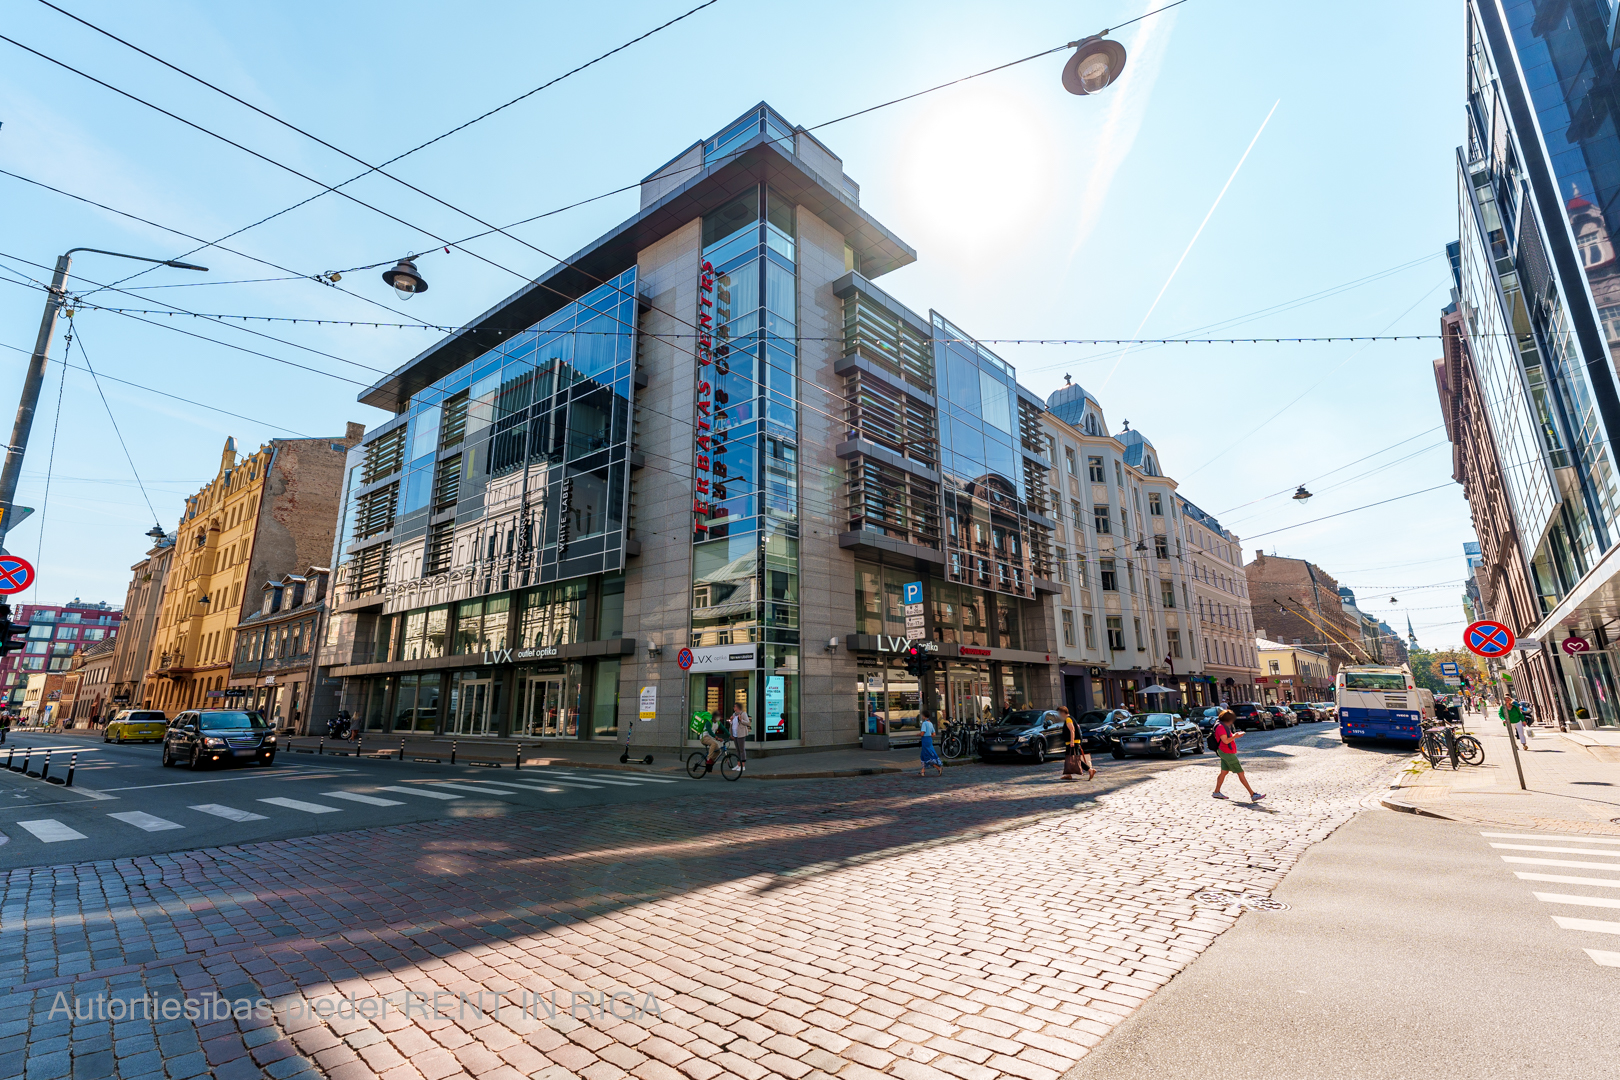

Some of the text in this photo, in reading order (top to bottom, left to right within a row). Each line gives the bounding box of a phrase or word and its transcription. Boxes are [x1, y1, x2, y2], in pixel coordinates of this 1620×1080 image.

[699, 259, 714, 366] CENTRS
[908, 585, 918, 602] P
[877, 634, 912, 654] LVX
[484, 646, 557, 665] LVX outlet optika
